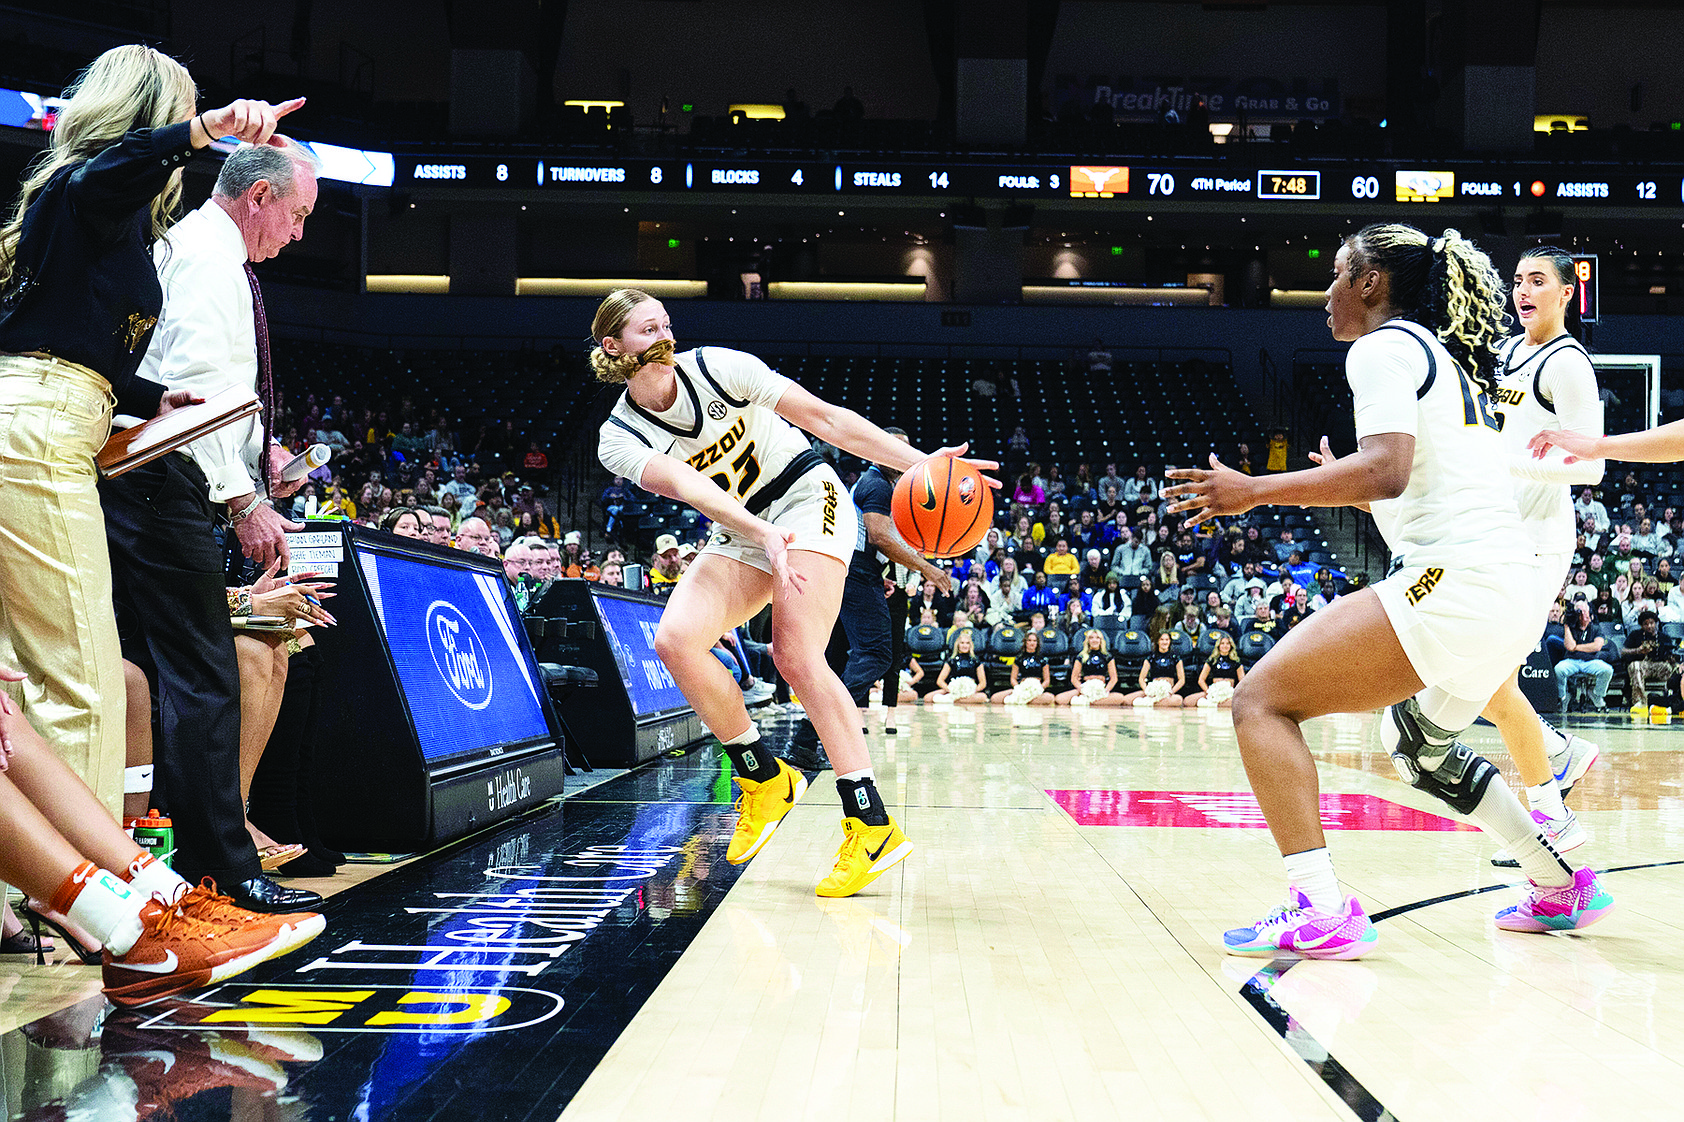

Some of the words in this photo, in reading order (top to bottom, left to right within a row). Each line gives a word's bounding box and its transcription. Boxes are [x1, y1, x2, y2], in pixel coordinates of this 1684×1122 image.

[1095, 86, 1224, 111] BreakTie
[1285, 97, 1299, 111] &
[414, 164, 467, 179] ASSISTS
[496, 163, 509, 181] 8
[550, 166, 626, 183] TURNOVERS
[650, 166, 663, 184] 8
[711, 169, 760, 185] BLOCKS
[791, 168, 804, 186] 4
[853, 171, 902, 187] STEALS
[928, 171, 949, 189] 14
[999, 175, 1040, 189] FOULS:
[1049, 174, 1060, 189] 3
[1147, 173, 1175, 195] 70
[1191, 178, 1214, 190] 4TH
[1215, 178, 1251, 192] Period
[1271, 177, 1307, 194] 7:48
[1351, 176, 1380, 199] 60
[1461, 182, 1503, 196] FOULS:
[1513, 182, 1521, 196] 1
[1556, 182, 1609, 198] ASSISTS
[1636, 181, 1657, 199] 12
[437, 614, 485, 690] Ford
[1521, 665, 1550, 679] Care
[495, 769, 517, 810] Health
[517, 767, 531, 799] Care
[296, 886, 637, 977] Health
